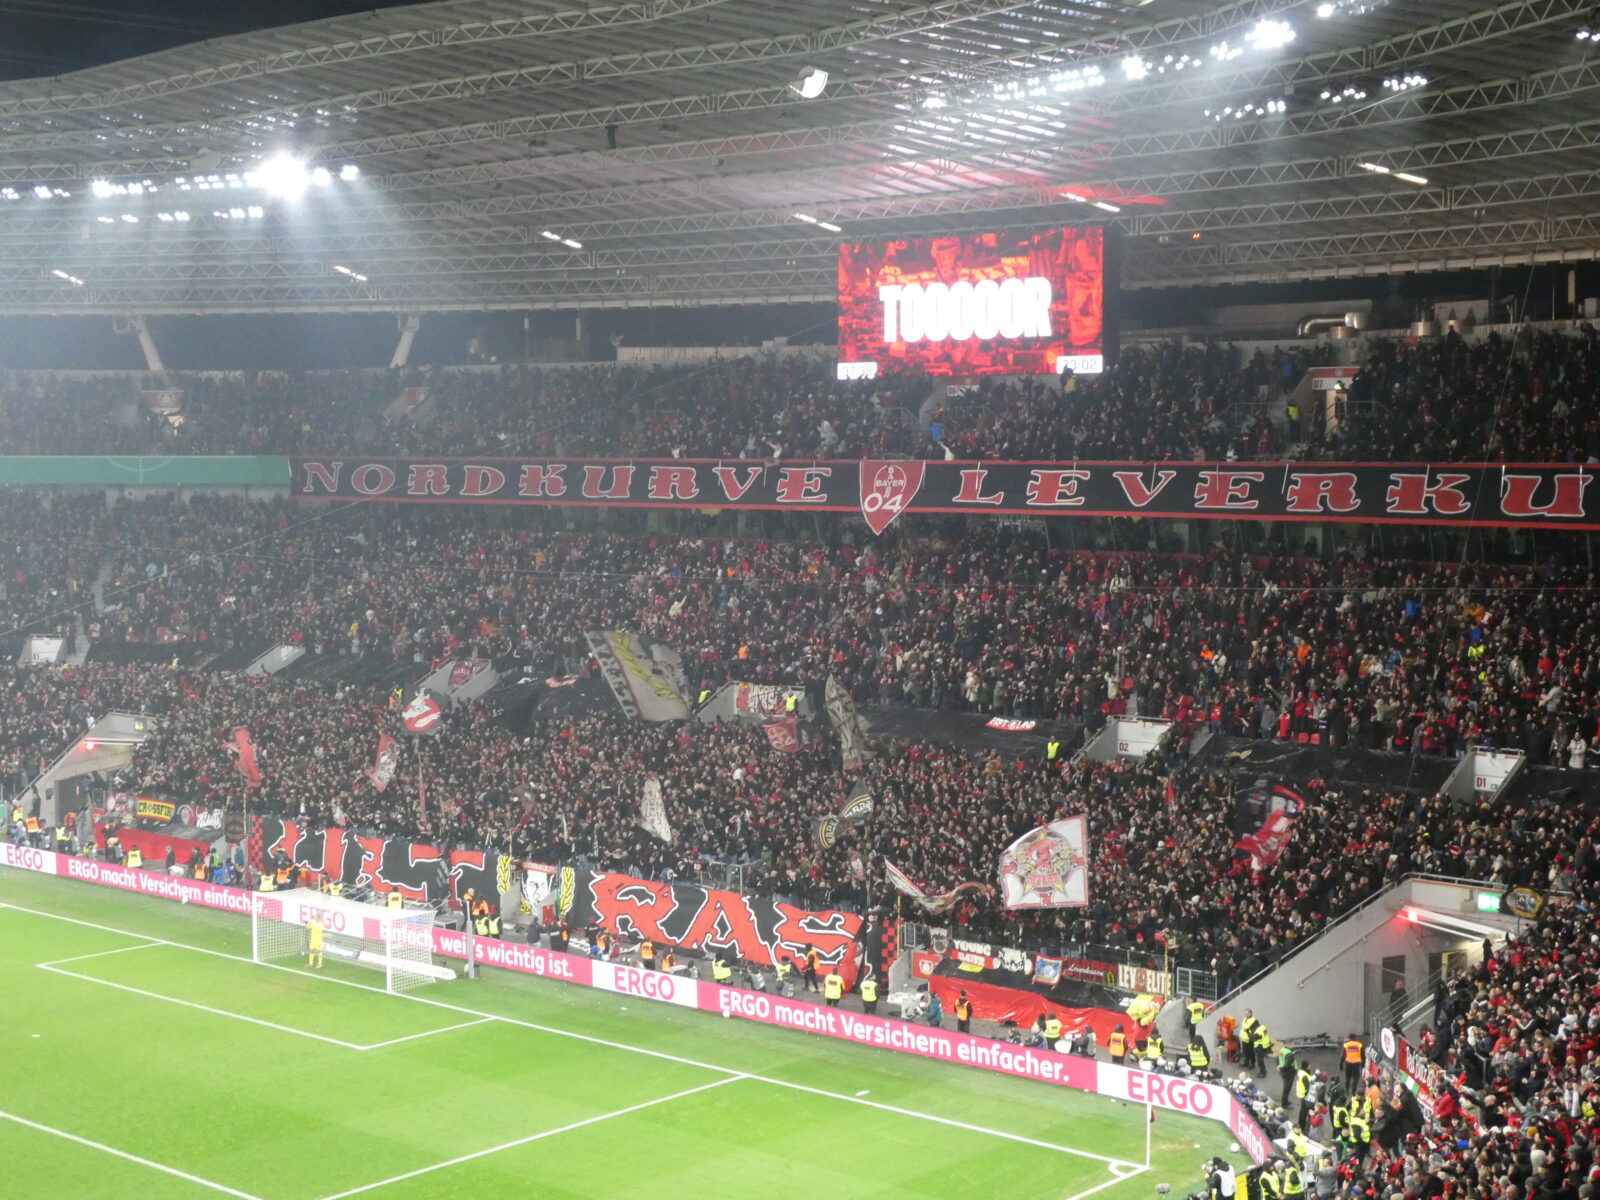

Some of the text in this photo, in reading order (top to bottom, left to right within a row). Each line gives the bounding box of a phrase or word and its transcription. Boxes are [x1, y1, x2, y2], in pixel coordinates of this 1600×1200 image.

[302, 462, 1594, 518] NORDKURVE LEVERKU
[875, 479, 905, 487] BAYER
[864, 492, 903, 513] 04
[1119, 742, 1129, 752] D2
[1476, 777, 1486, 788] D1
[7, 846, 43, 871] ERGO
[68, 859, 268, 915] ERGO macht Versichern einfacher.
[487, 944, 545, 977] wichtig
[549, 954, 573, 978] ist.
[953, 940, 991, 957] YOUNG
[614, 966, 675, 1000] ERGO
[1119, 964, 1136, 989] LEV
[719, 988, 1070, 1083] ERGO macht Versichern einfacher.
[1127, 1068, 1213, 1115] ERGO
